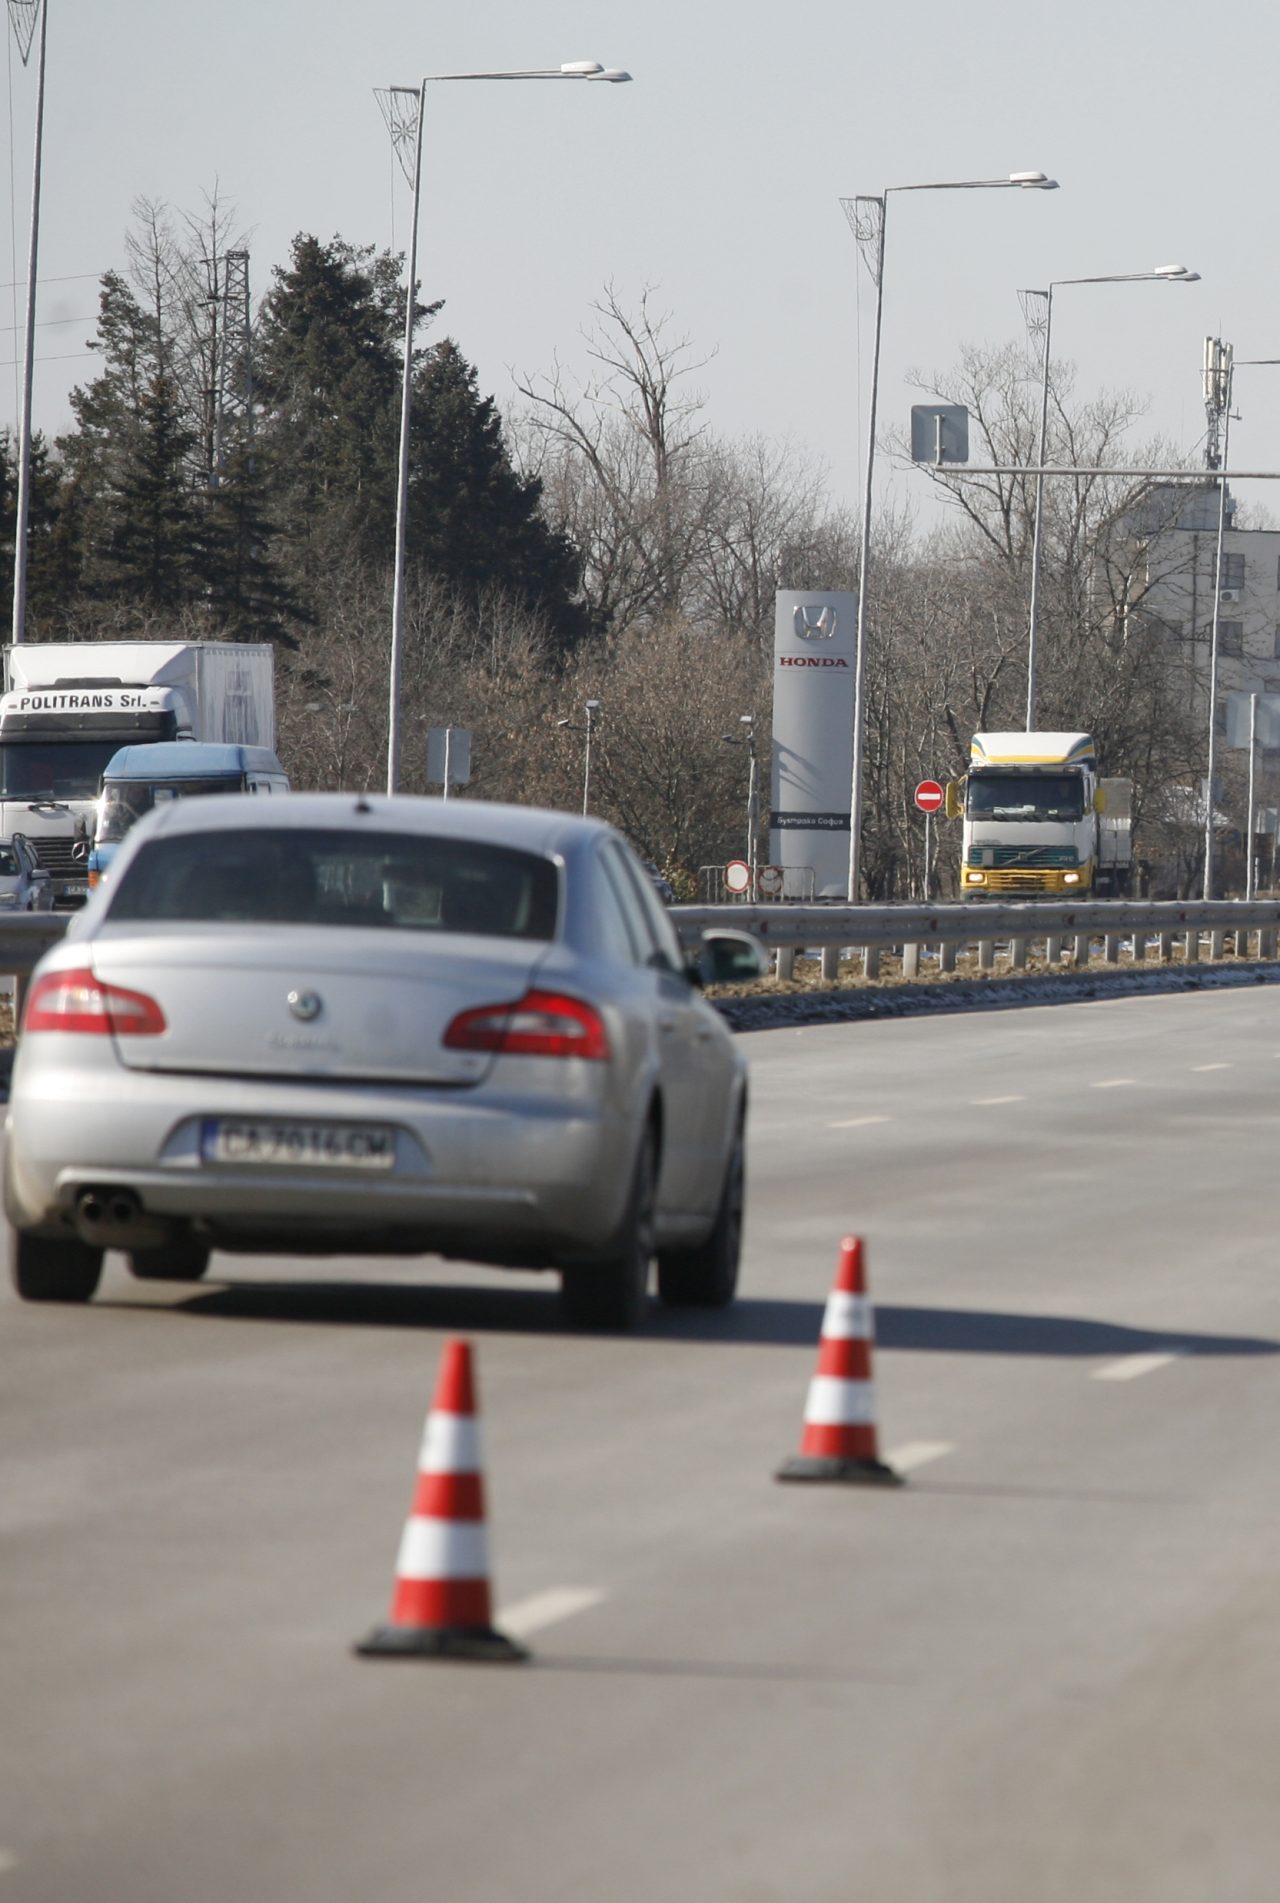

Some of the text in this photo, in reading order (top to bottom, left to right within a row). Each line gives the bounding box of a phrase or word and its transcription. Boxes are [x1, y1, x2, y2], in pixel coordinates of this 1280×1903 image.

[779, 657, 849, 668] HONDA
[20, 694, 147, 711] POLITRANS Srl.
